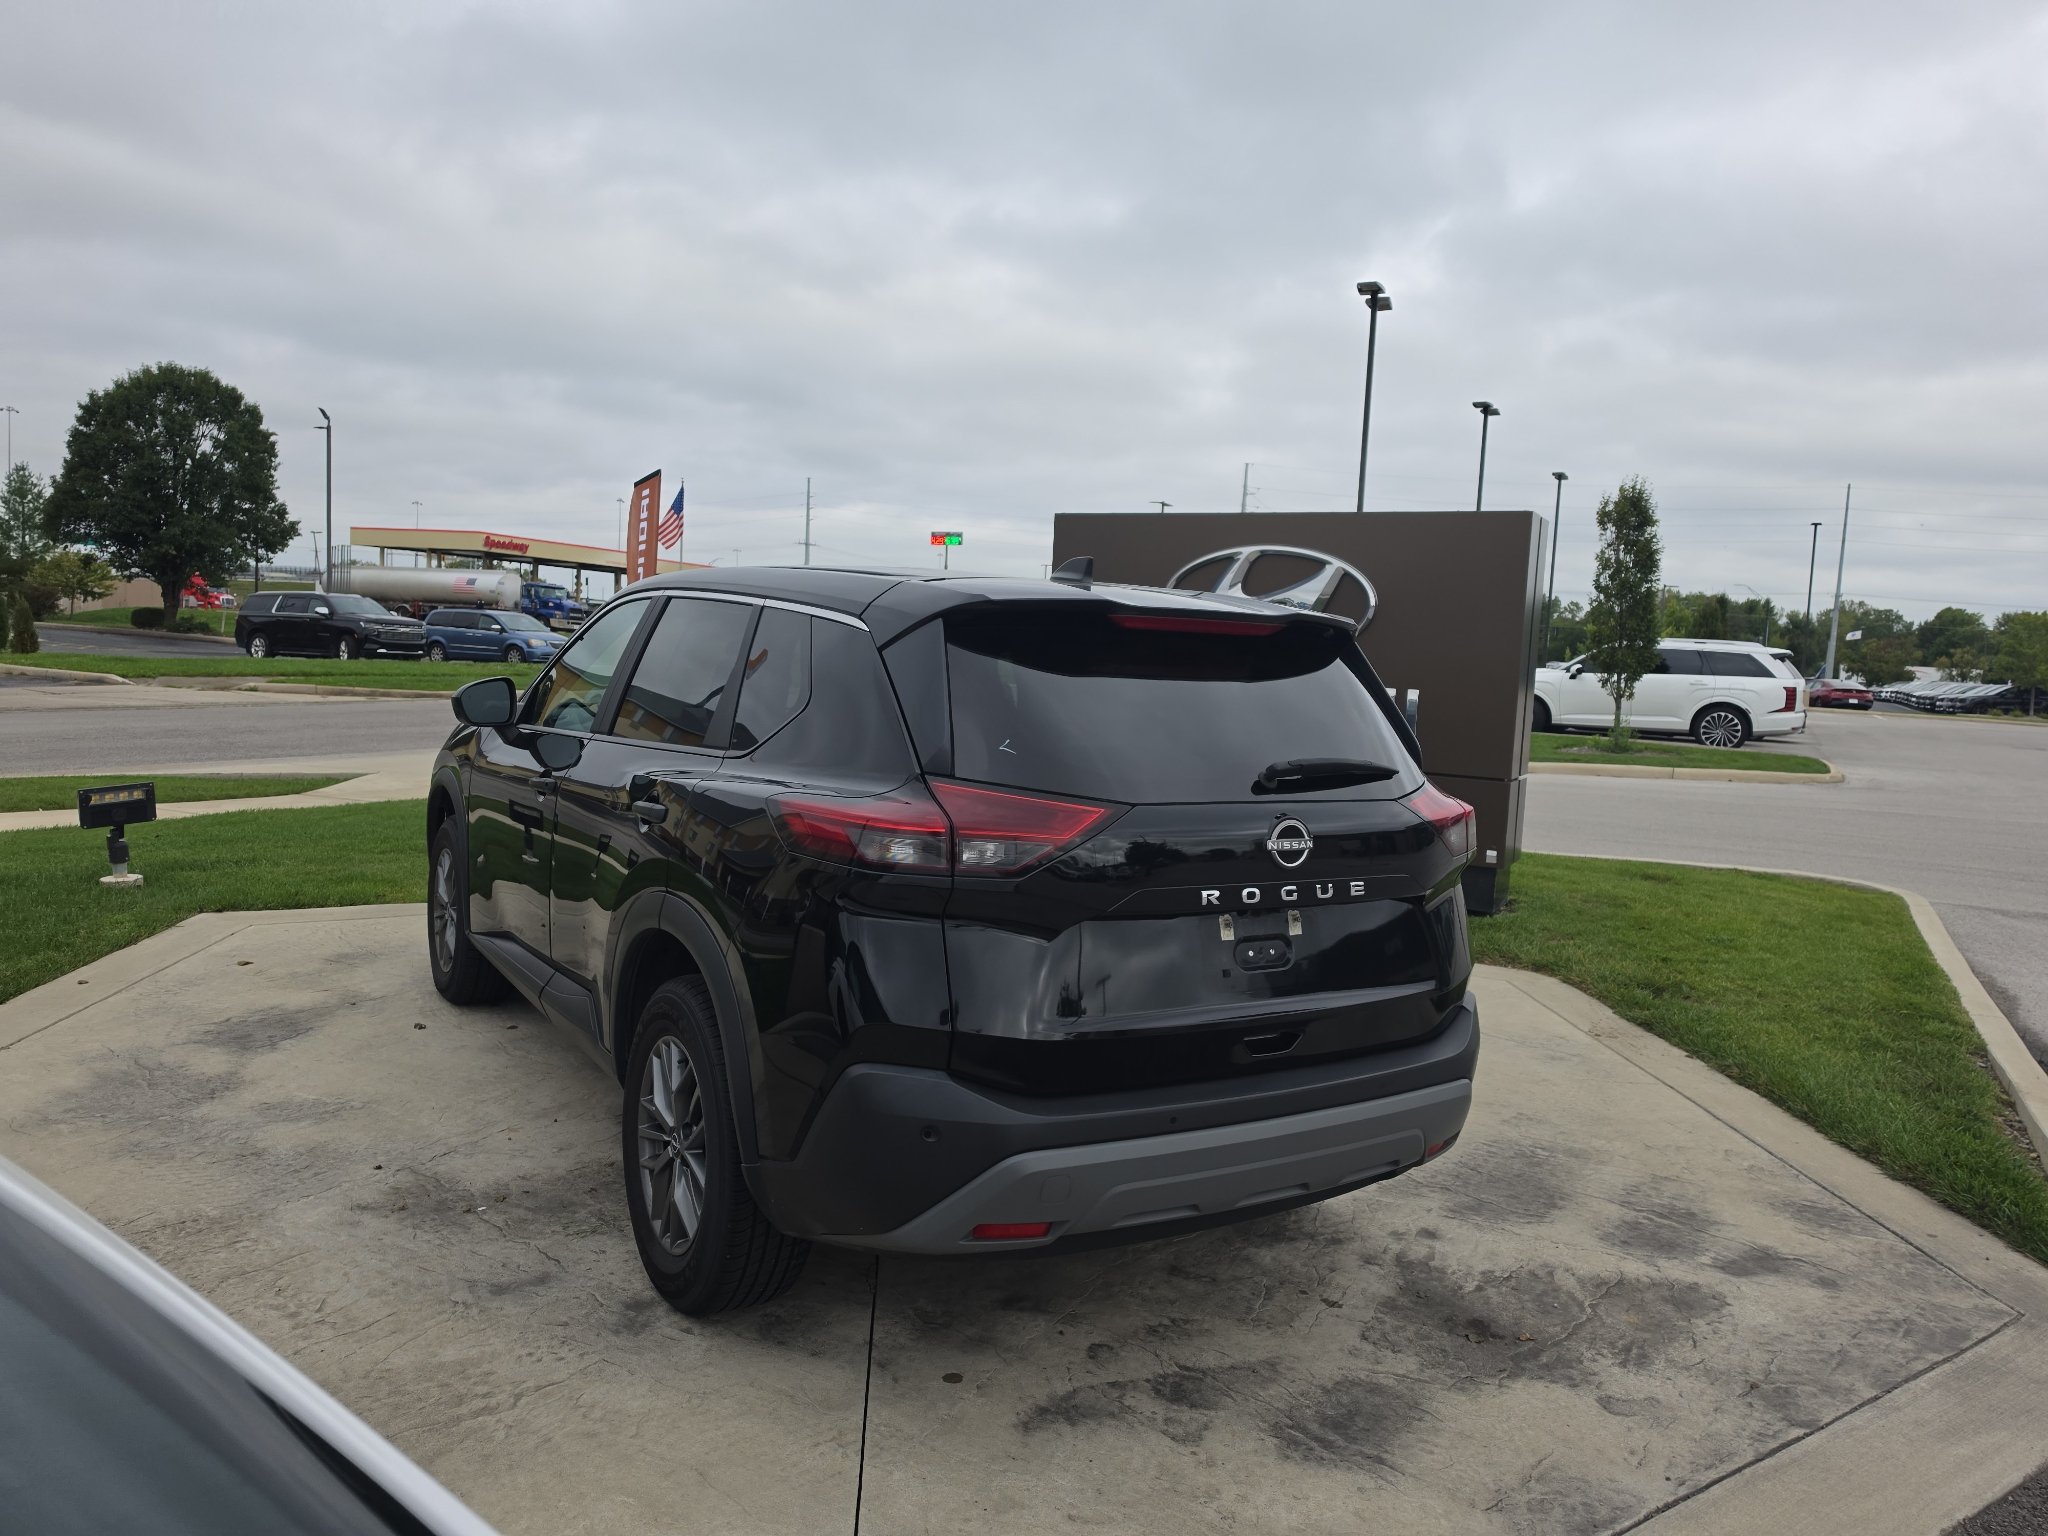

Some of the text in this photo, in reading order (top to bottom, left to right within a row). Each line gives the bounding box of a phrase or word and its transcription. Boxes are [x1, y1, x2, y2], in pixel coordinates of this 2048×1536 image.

[483, 535, 530, 554] Speedway
[1268, 840, 1313, 850] NISSAN
[1200, 881, 1366, 906] ROGUE
